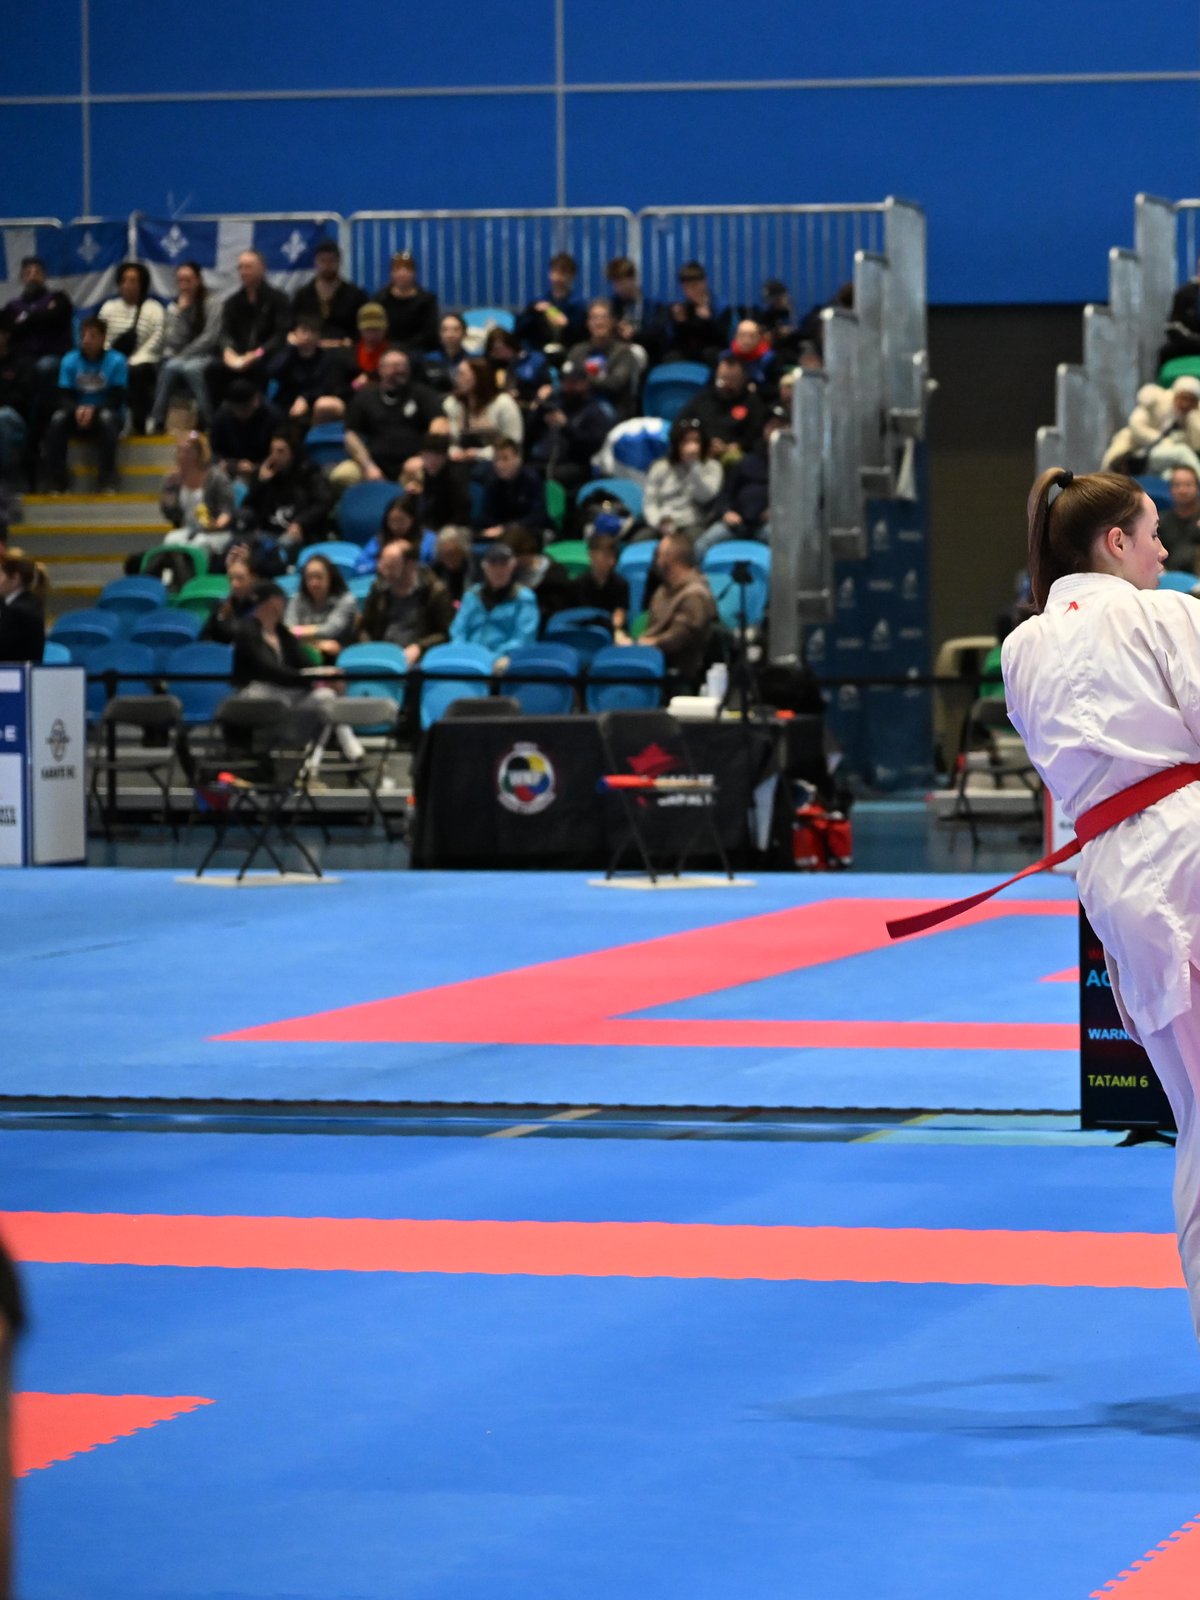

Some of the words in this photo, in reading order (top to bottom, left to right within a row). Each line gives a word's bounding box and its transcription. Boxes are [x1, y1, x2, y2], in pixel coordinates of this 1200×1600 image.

[1088, 1028, 1131, 1040] WARN
[1088, 1075, 1136, 1087] TATAMI
[1139, 1076, 1148, 1088] 6
